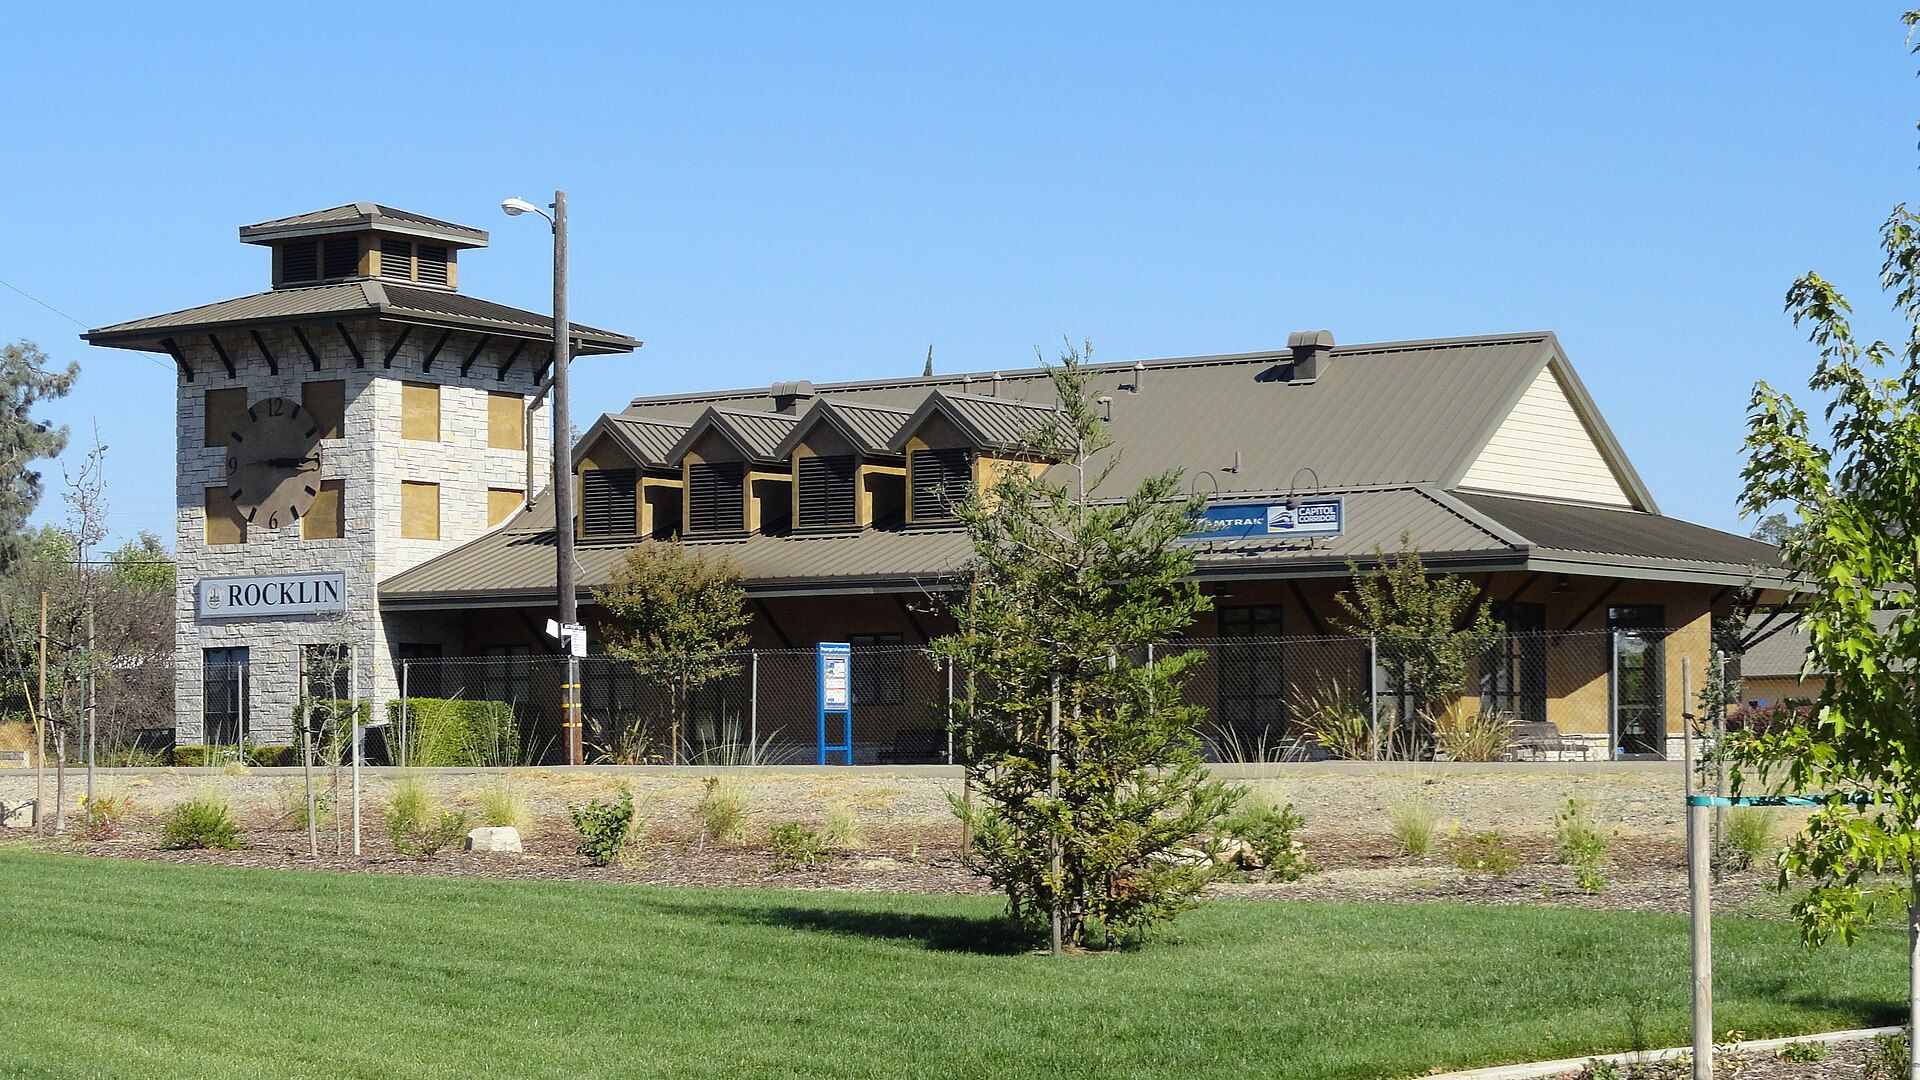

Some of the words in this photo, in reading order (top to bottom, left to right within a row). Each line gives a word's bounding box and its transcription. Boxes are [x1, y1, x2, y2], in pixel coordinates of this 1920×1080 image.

[267, 398, 284, 418] 12
[228, 456, 238, 476] 9
[268, 510, 279, 530] 6
[1299, 507, 1335, 515] CAPITOL
[227, 579, 340, 607] ROCKLIN
